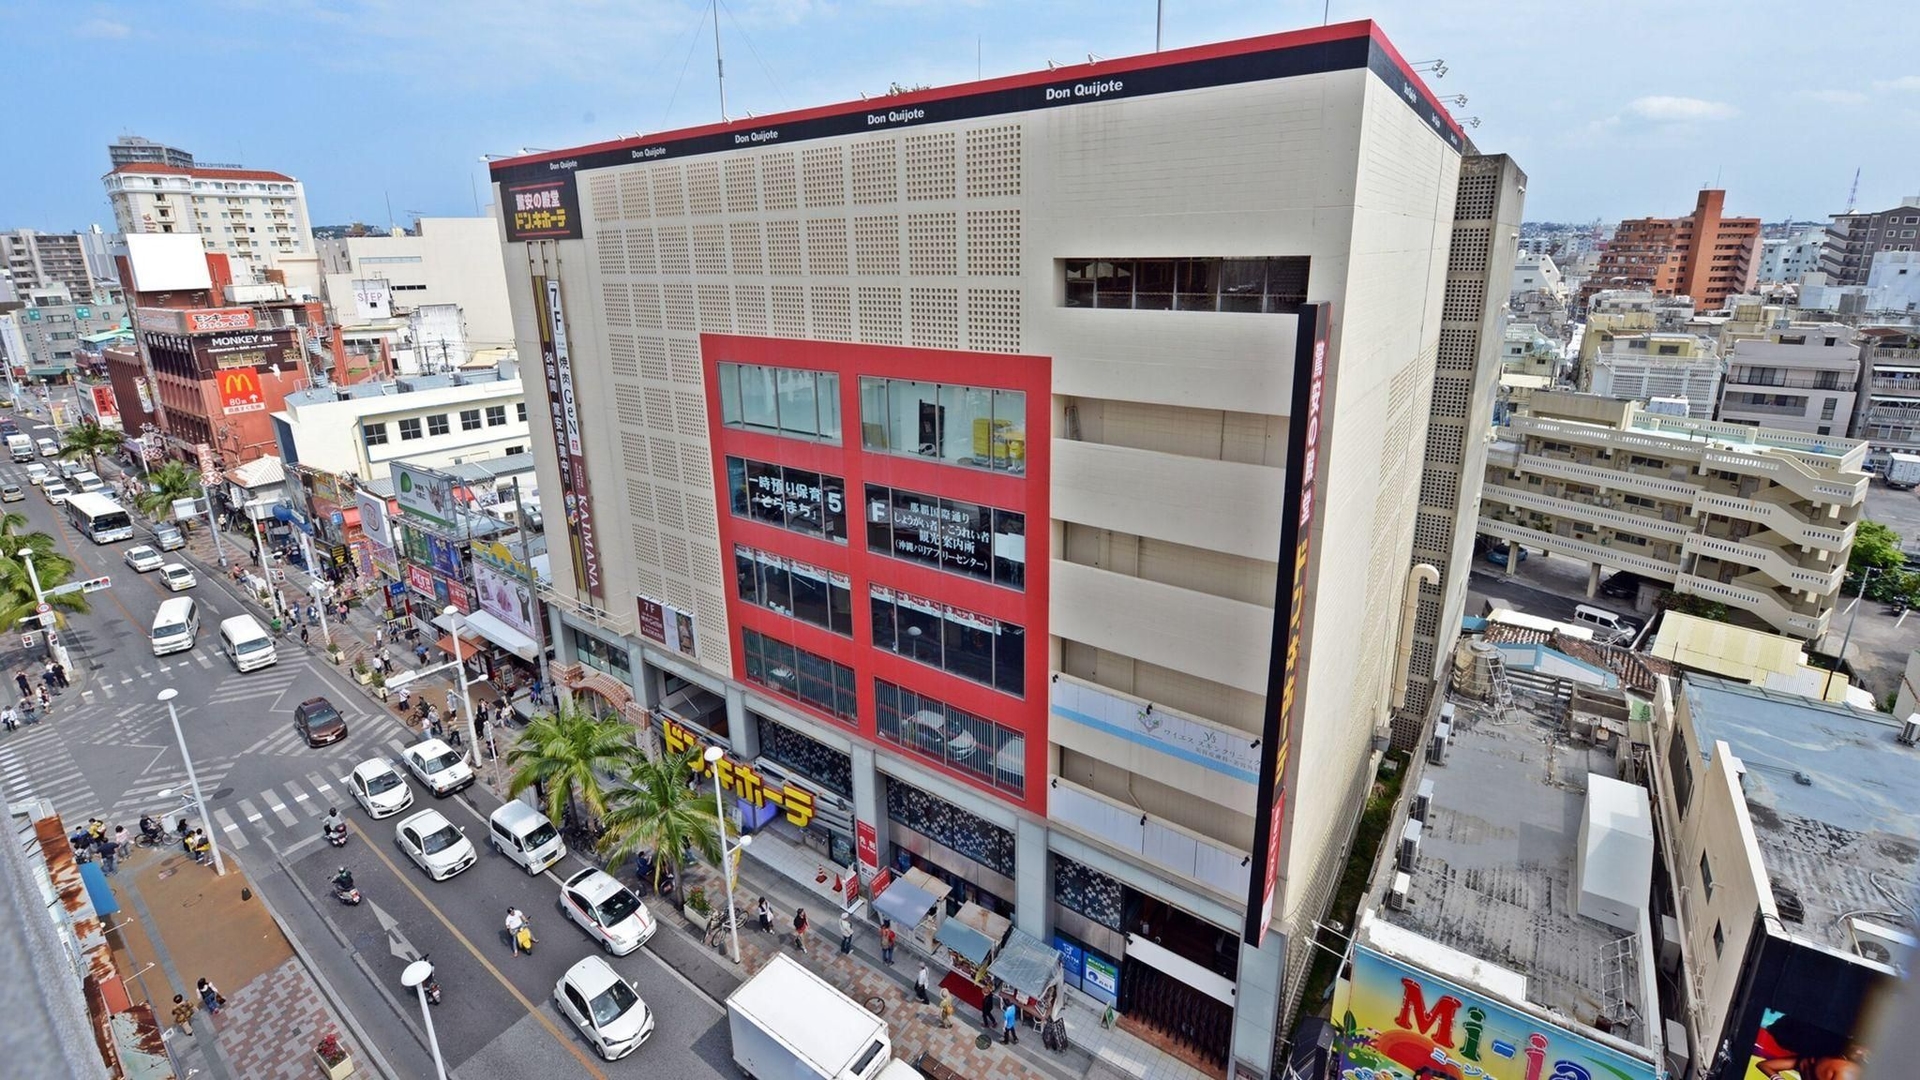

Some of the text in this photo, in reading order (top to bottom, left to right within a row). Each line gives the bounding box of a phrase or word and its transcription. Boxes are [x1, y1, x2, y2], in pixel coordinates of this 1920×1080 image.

[1045, 79, 1124, 101] Don Quijote
[867, 107, 925, 125] Don Quijote
[734, 130, 779, 144] Don Quijote
[631, 146, 667, 159] Don Quijote
[549, 159, 578, 171] Don Quijote
[357, 292, 383, 302] STEP
[211, 334, 259, 347] MONKEY
[748, 475, 822, 504] 一時預り保育
[827, 492, 843, 514] 5
[909, 501, 971, 524] 那覇国際通り
[577, 493, 599, 588] KAIMANA
[918, 528, 976, 555] 観光案内所
